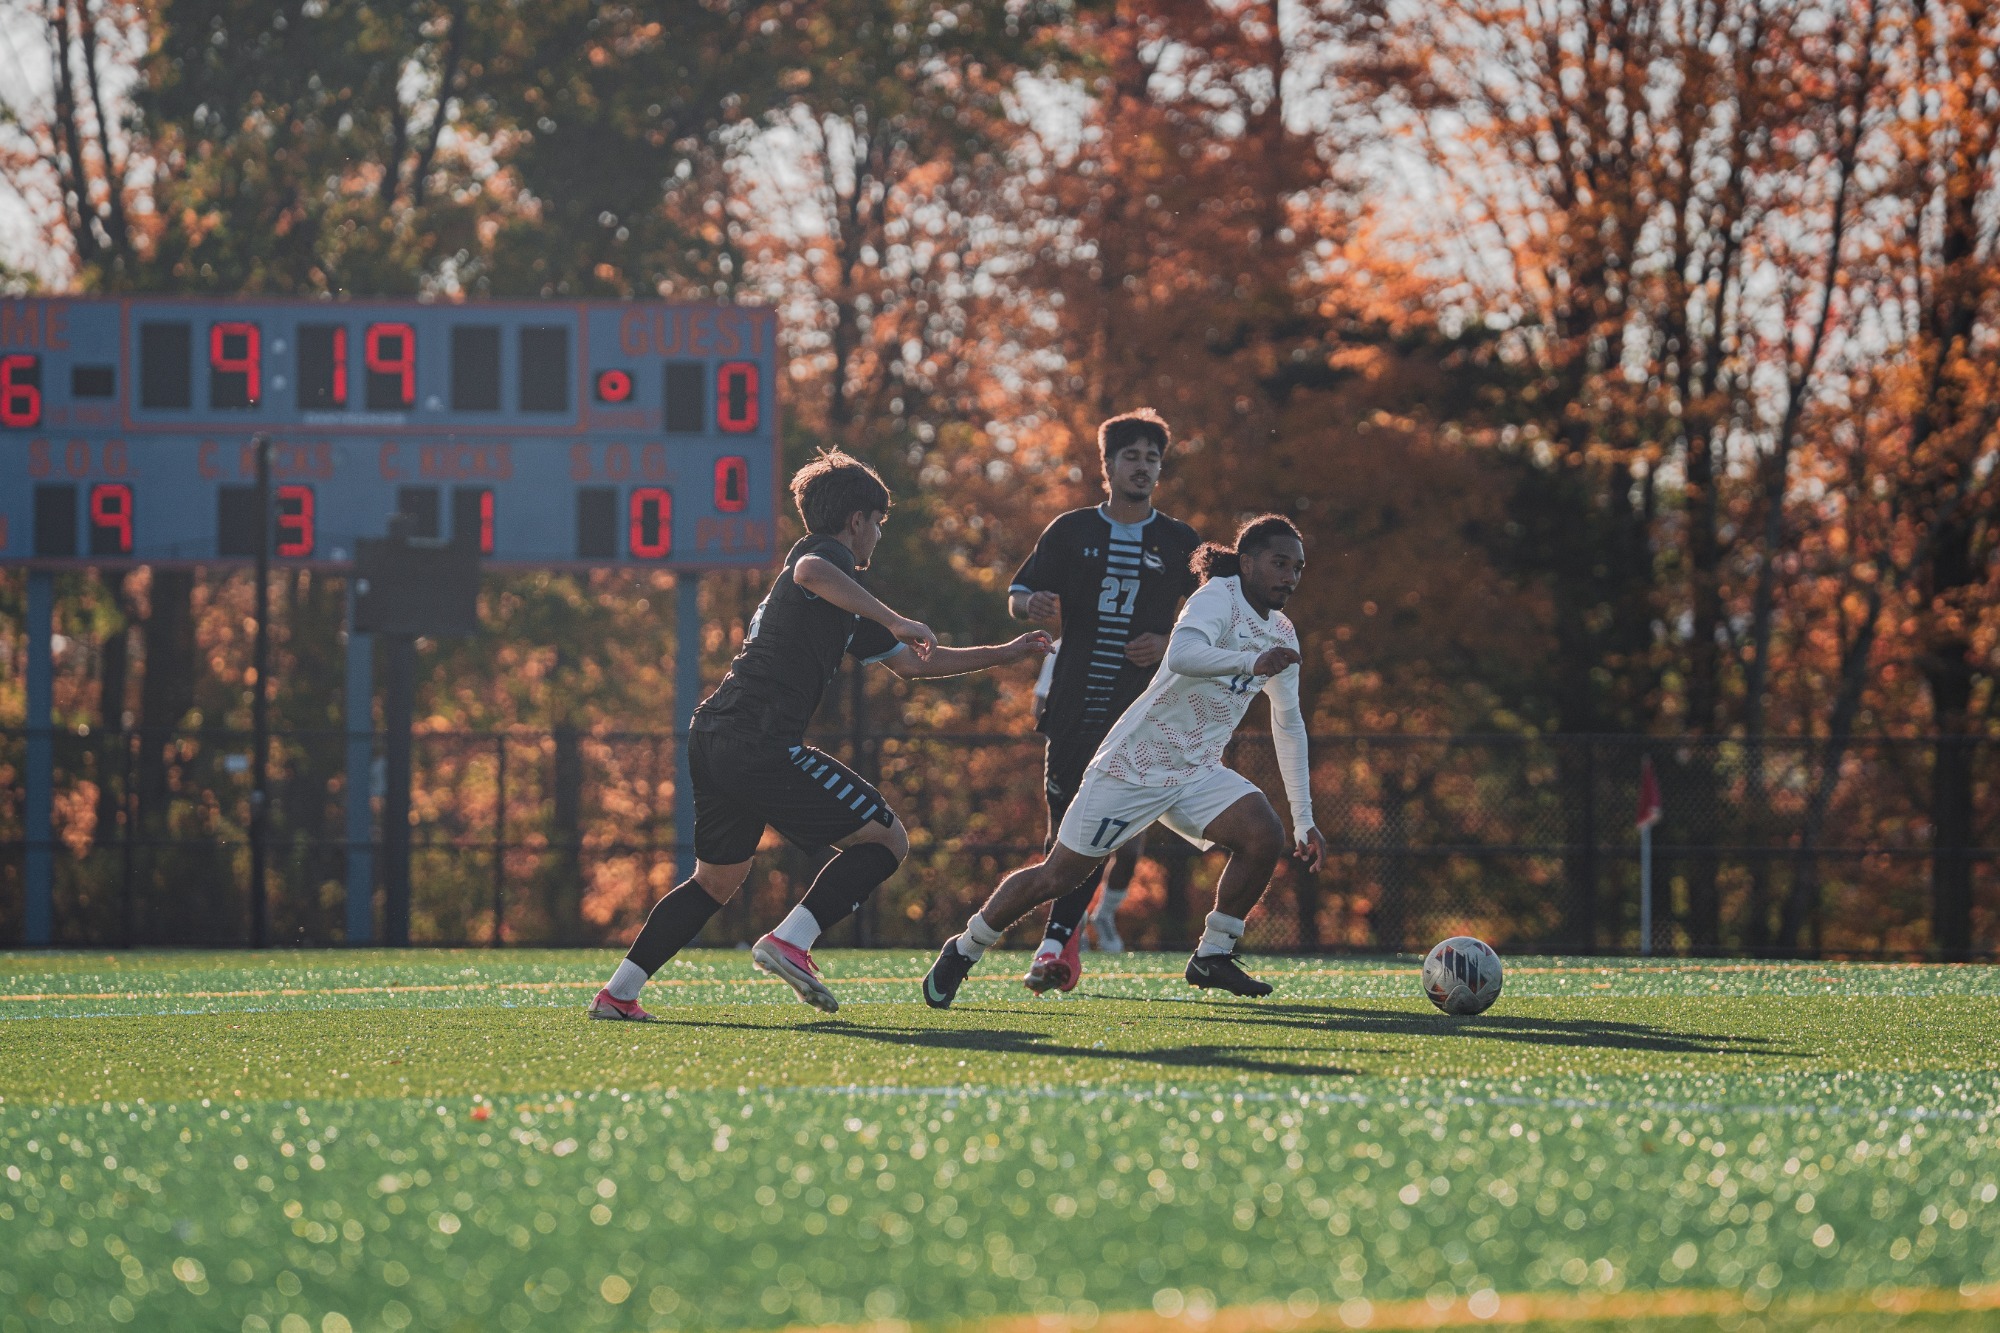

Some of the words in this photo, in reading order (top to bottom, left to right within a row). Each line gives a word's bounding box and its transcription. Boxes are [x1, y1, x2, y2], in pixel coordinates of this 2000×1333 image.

[621, 311, 768, 356] GUEST
[717, 361, 760, 434] 0
[420, 443, 513, 480] KICKS
[714, 456, 748, 513] 0
[90, 484, 134, 553] 9
[277, 486, 314, 558] 3
[479, 490, 495, 554] 1
[629, 487, 673, 559] 0
[696, 518, 767, 554] PEN
[1098, 576, 1141, 615] 27
[1090, 817, 1130, 849] 17
